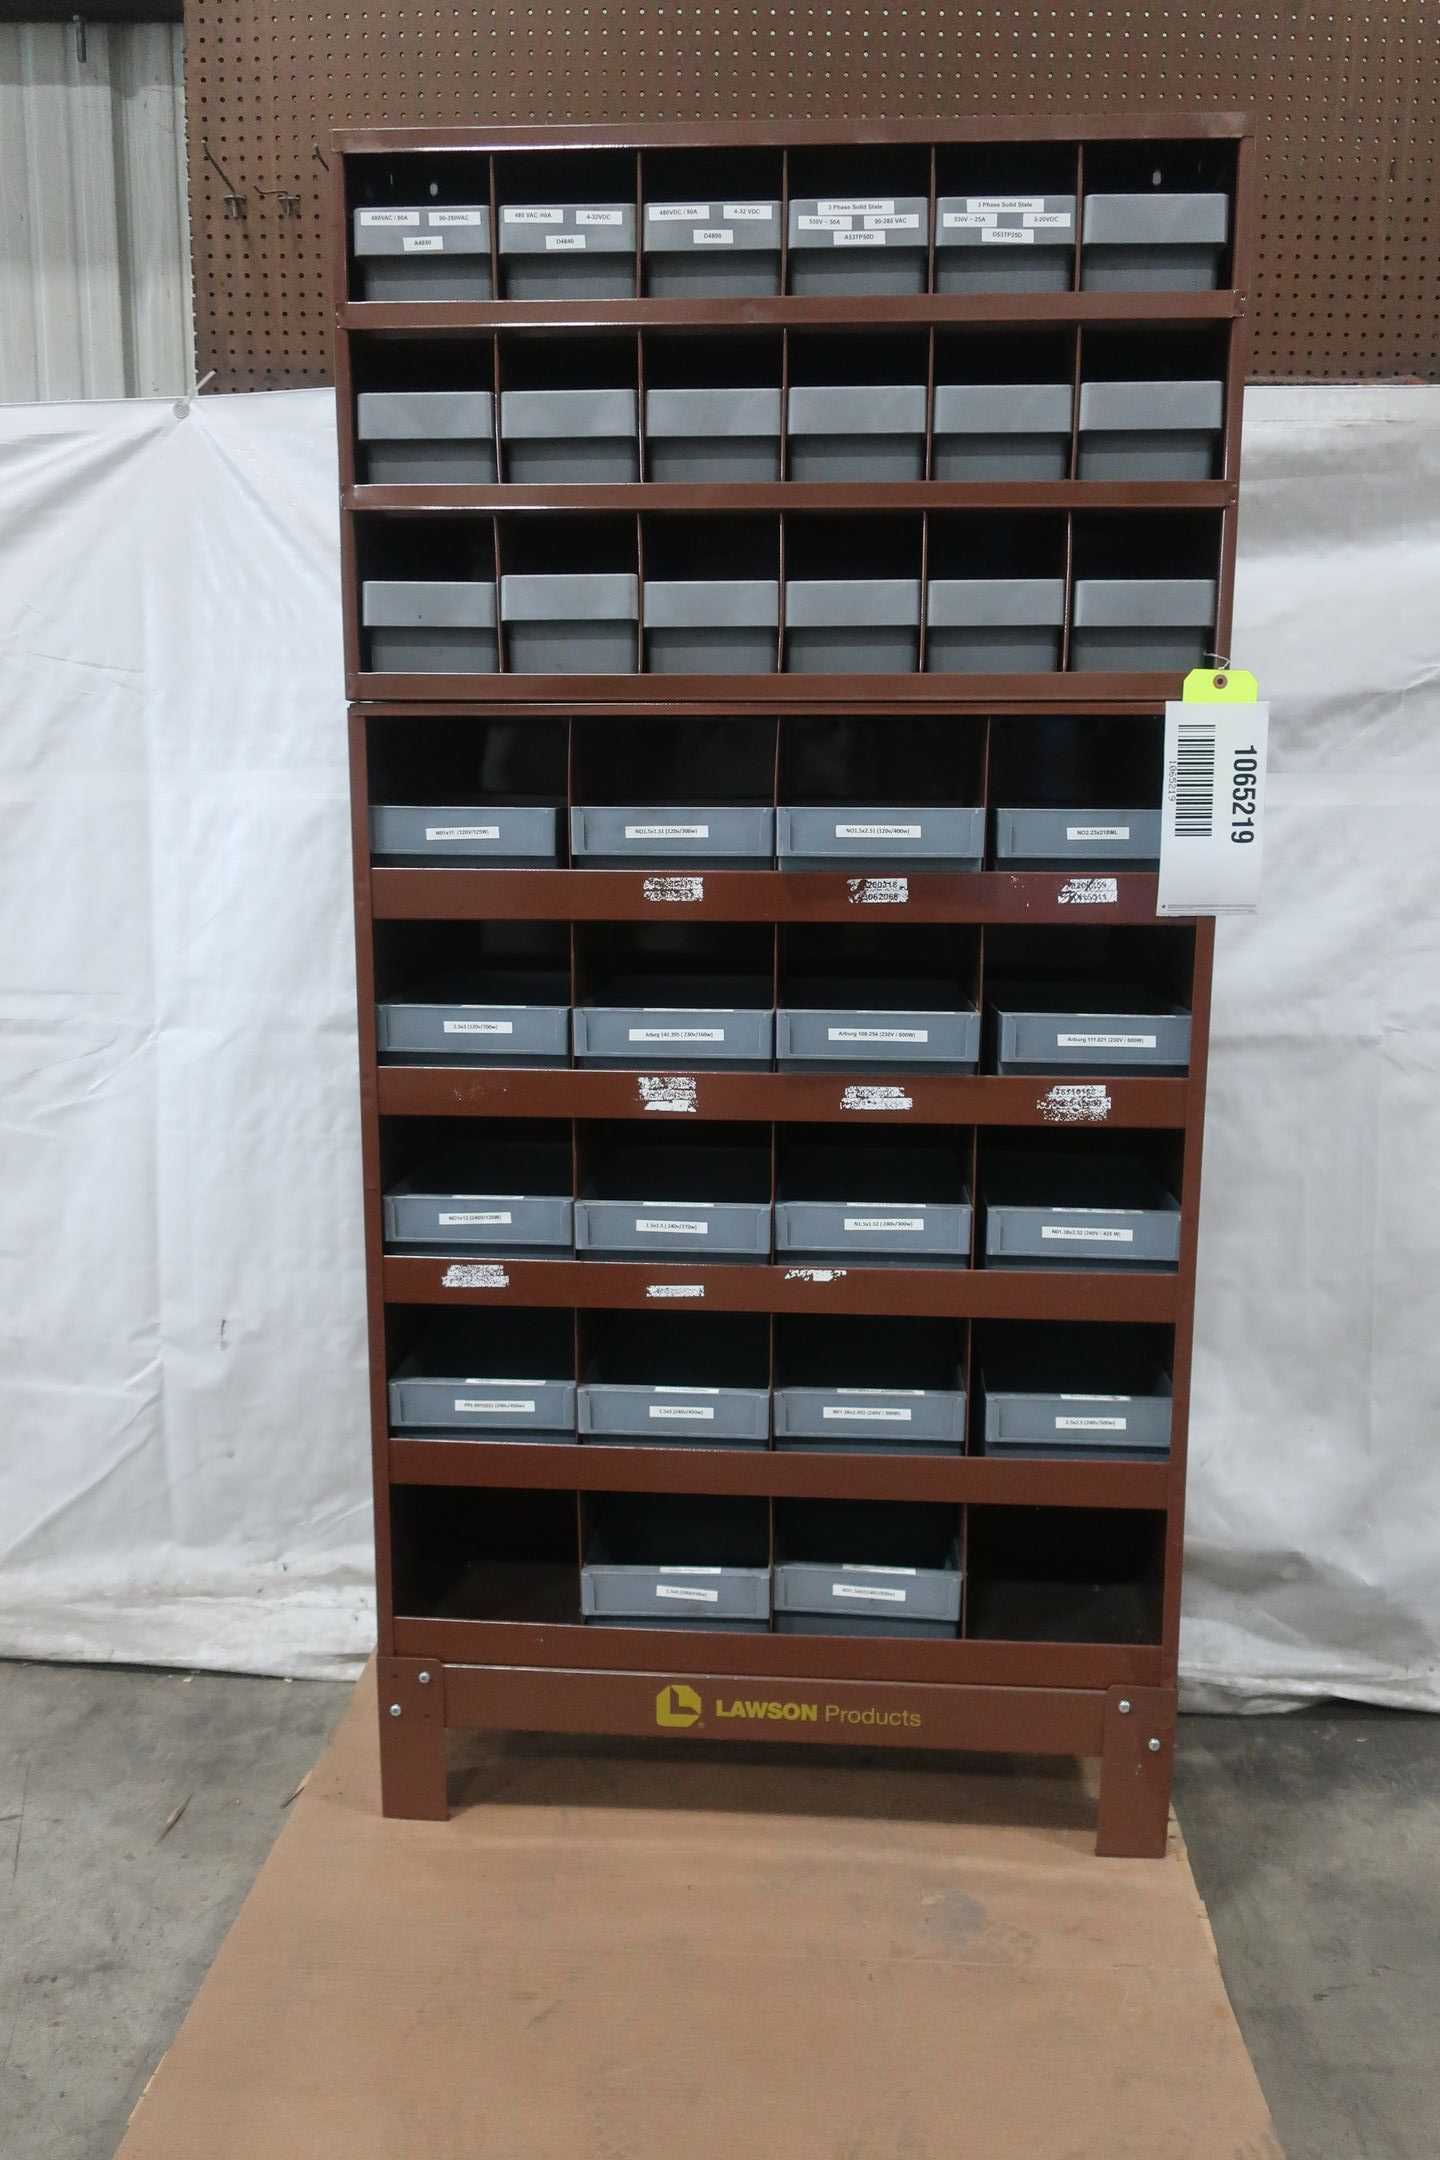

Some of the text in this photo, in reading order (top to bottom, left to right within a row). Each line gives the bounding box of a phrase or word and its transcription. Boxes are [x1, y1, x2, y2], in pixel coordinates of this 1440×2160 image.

[1167, 759, 1178, 802] 1065219
[1230, 744, 1258, 844] 1065219
[715, 1699, 922, 1727] LAWSON Products
